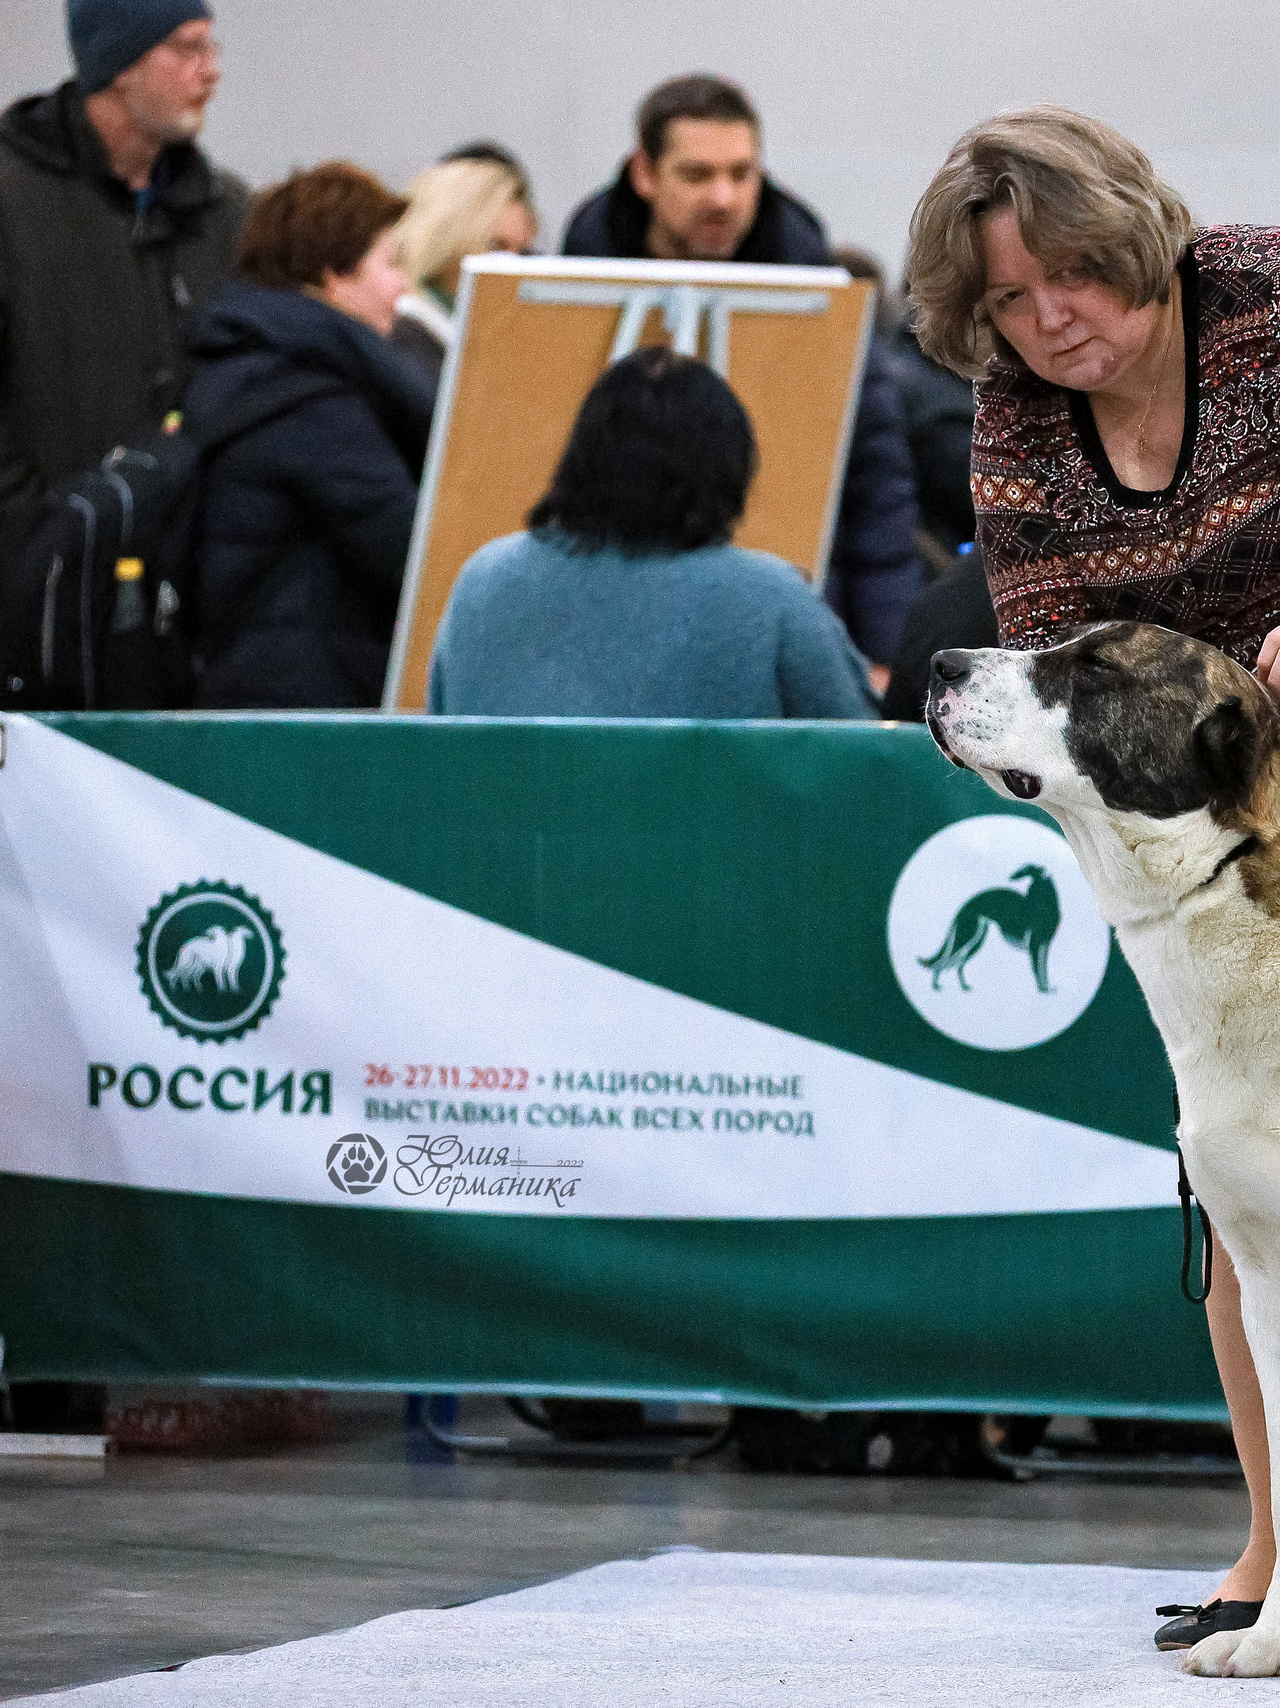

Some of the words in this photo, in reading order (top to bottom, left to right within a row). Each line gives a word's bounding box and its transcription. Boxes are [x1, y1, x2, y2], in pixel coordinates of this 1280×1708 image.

[87, 1061, 333, 1116] РОССИЯ
[553, 1069, 804, 1099] НАЦИОНАЛЬНЫЕ
[364, 1097, 518, 1125] ВЫСТАВКИ
[526, 1102, 623, 1129] СОБАК
[633, 1106, 704, 1132] ВСЕХ
[714, 1107, 815, 1138] ПОРОД
